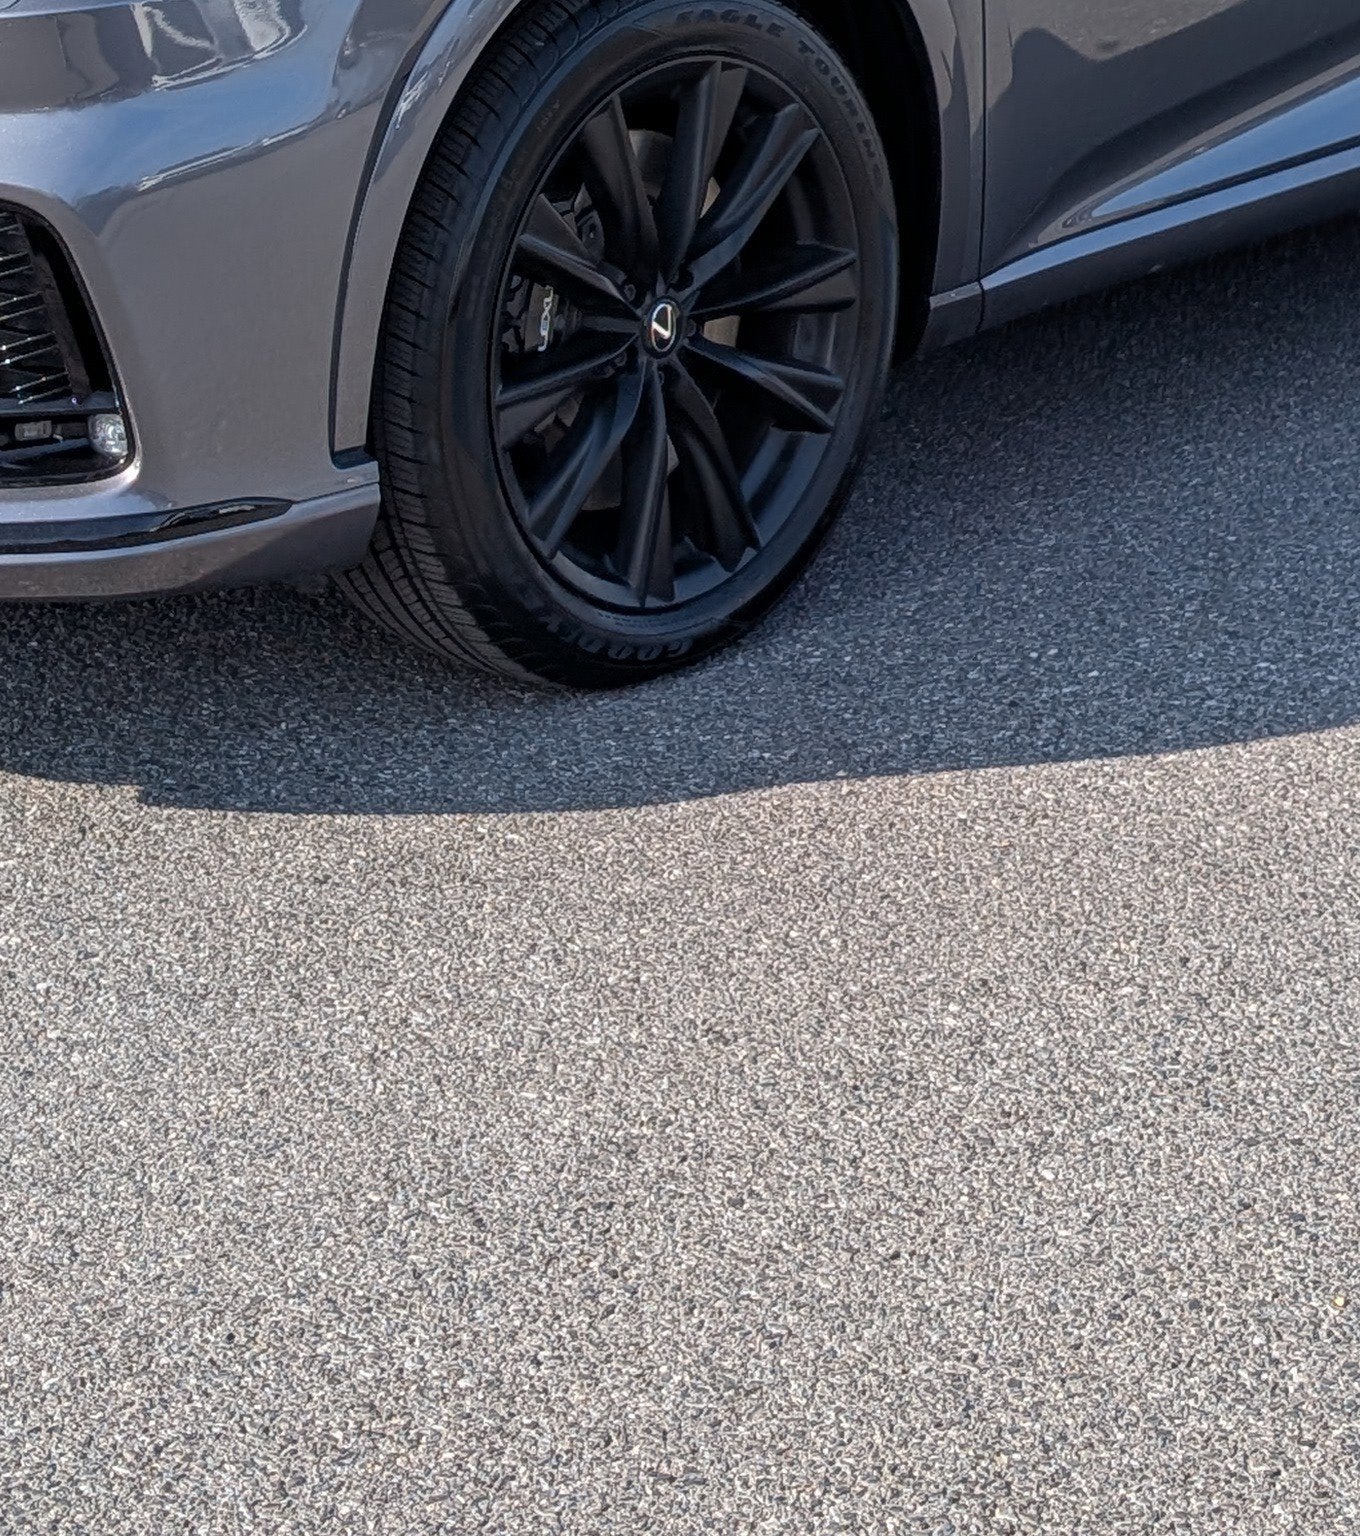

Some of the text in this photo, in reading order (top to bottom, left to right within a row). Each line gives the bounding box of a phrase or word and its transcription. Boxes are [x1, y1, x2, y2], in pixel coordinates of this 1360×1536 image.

[675, 8, 884, 190] EAGLE TOURING
[537, 284, 554, 352] LEXU
